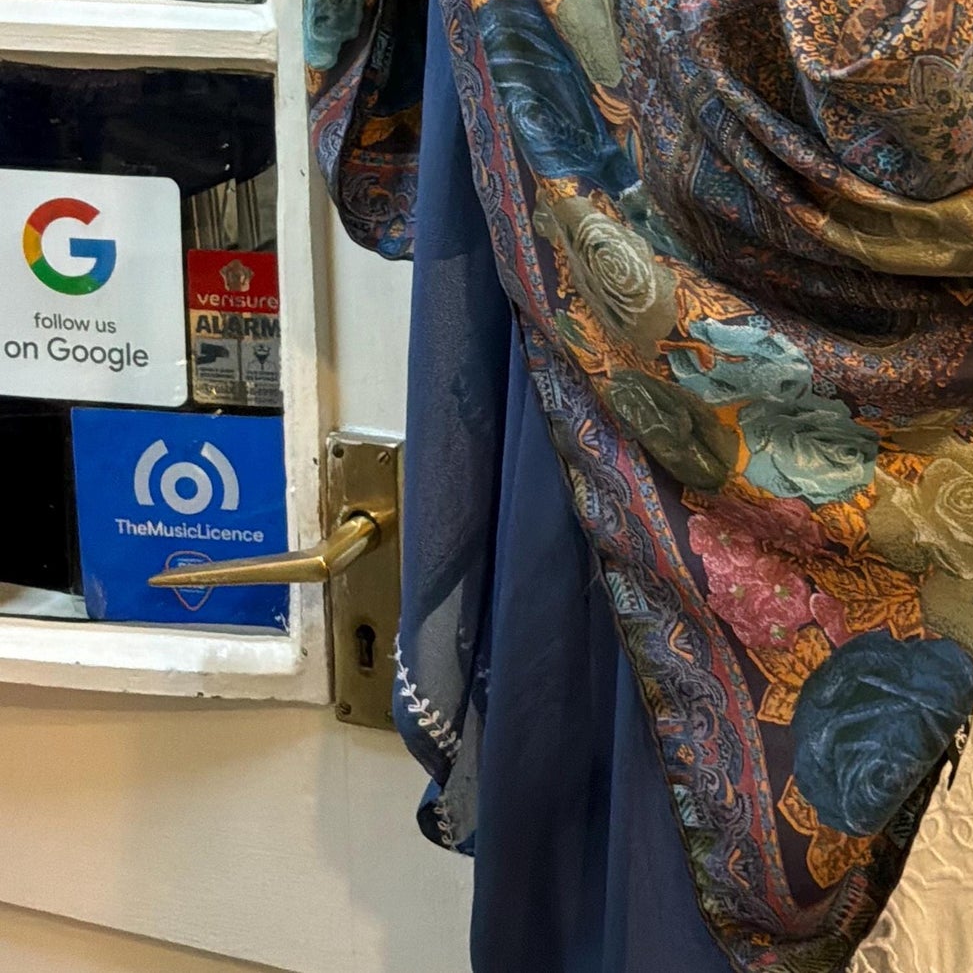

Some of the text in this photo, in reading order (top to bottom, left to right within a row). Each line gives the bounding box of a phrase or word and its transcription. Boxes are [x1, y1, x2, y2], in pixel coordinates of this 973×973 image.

[34, 312, 117, 334] follow us
[195, 314, 281, 338] ALARM
[4, 337, 149, 372] on Google
[115, 518, 264, 543] TheMusicLicence
